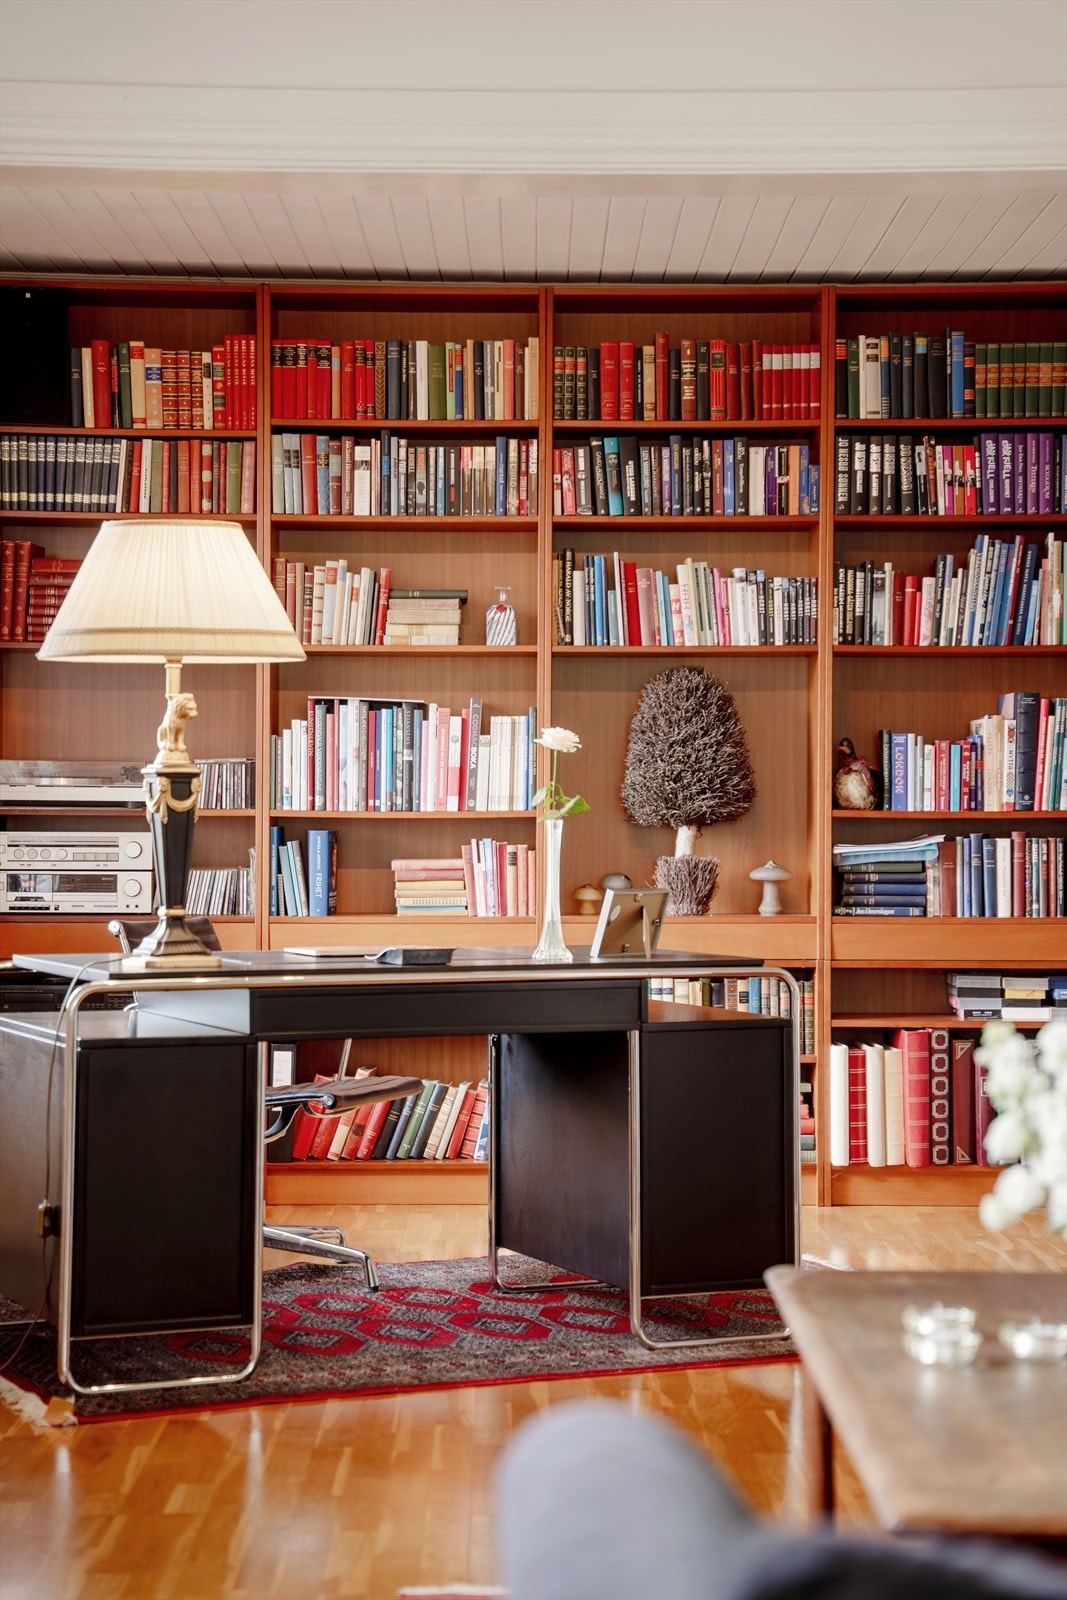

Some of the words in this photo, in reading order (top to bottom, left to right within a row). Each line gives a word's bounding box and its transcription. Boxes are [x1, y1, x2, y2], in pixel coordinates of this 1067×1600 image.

[839, 438, 848, 446] JO
[855, 442, 866, 451] JO
[870, 444, 881, 452] JO
[884, 444, 895, 453] JO
[900, 444, 911, 456] JO
[839, 448, 848, 471] NESBØ
[986, 457, 996, 479] FJELL
[1003, 457, 1012, 479] FJELL
[838, 473, 848, 501] SØNNEN
[566, 589, 571, 598] AV
[470, 714, 479, 769] COGNACBOKA
[895, 747, 904, 794] LONDON
